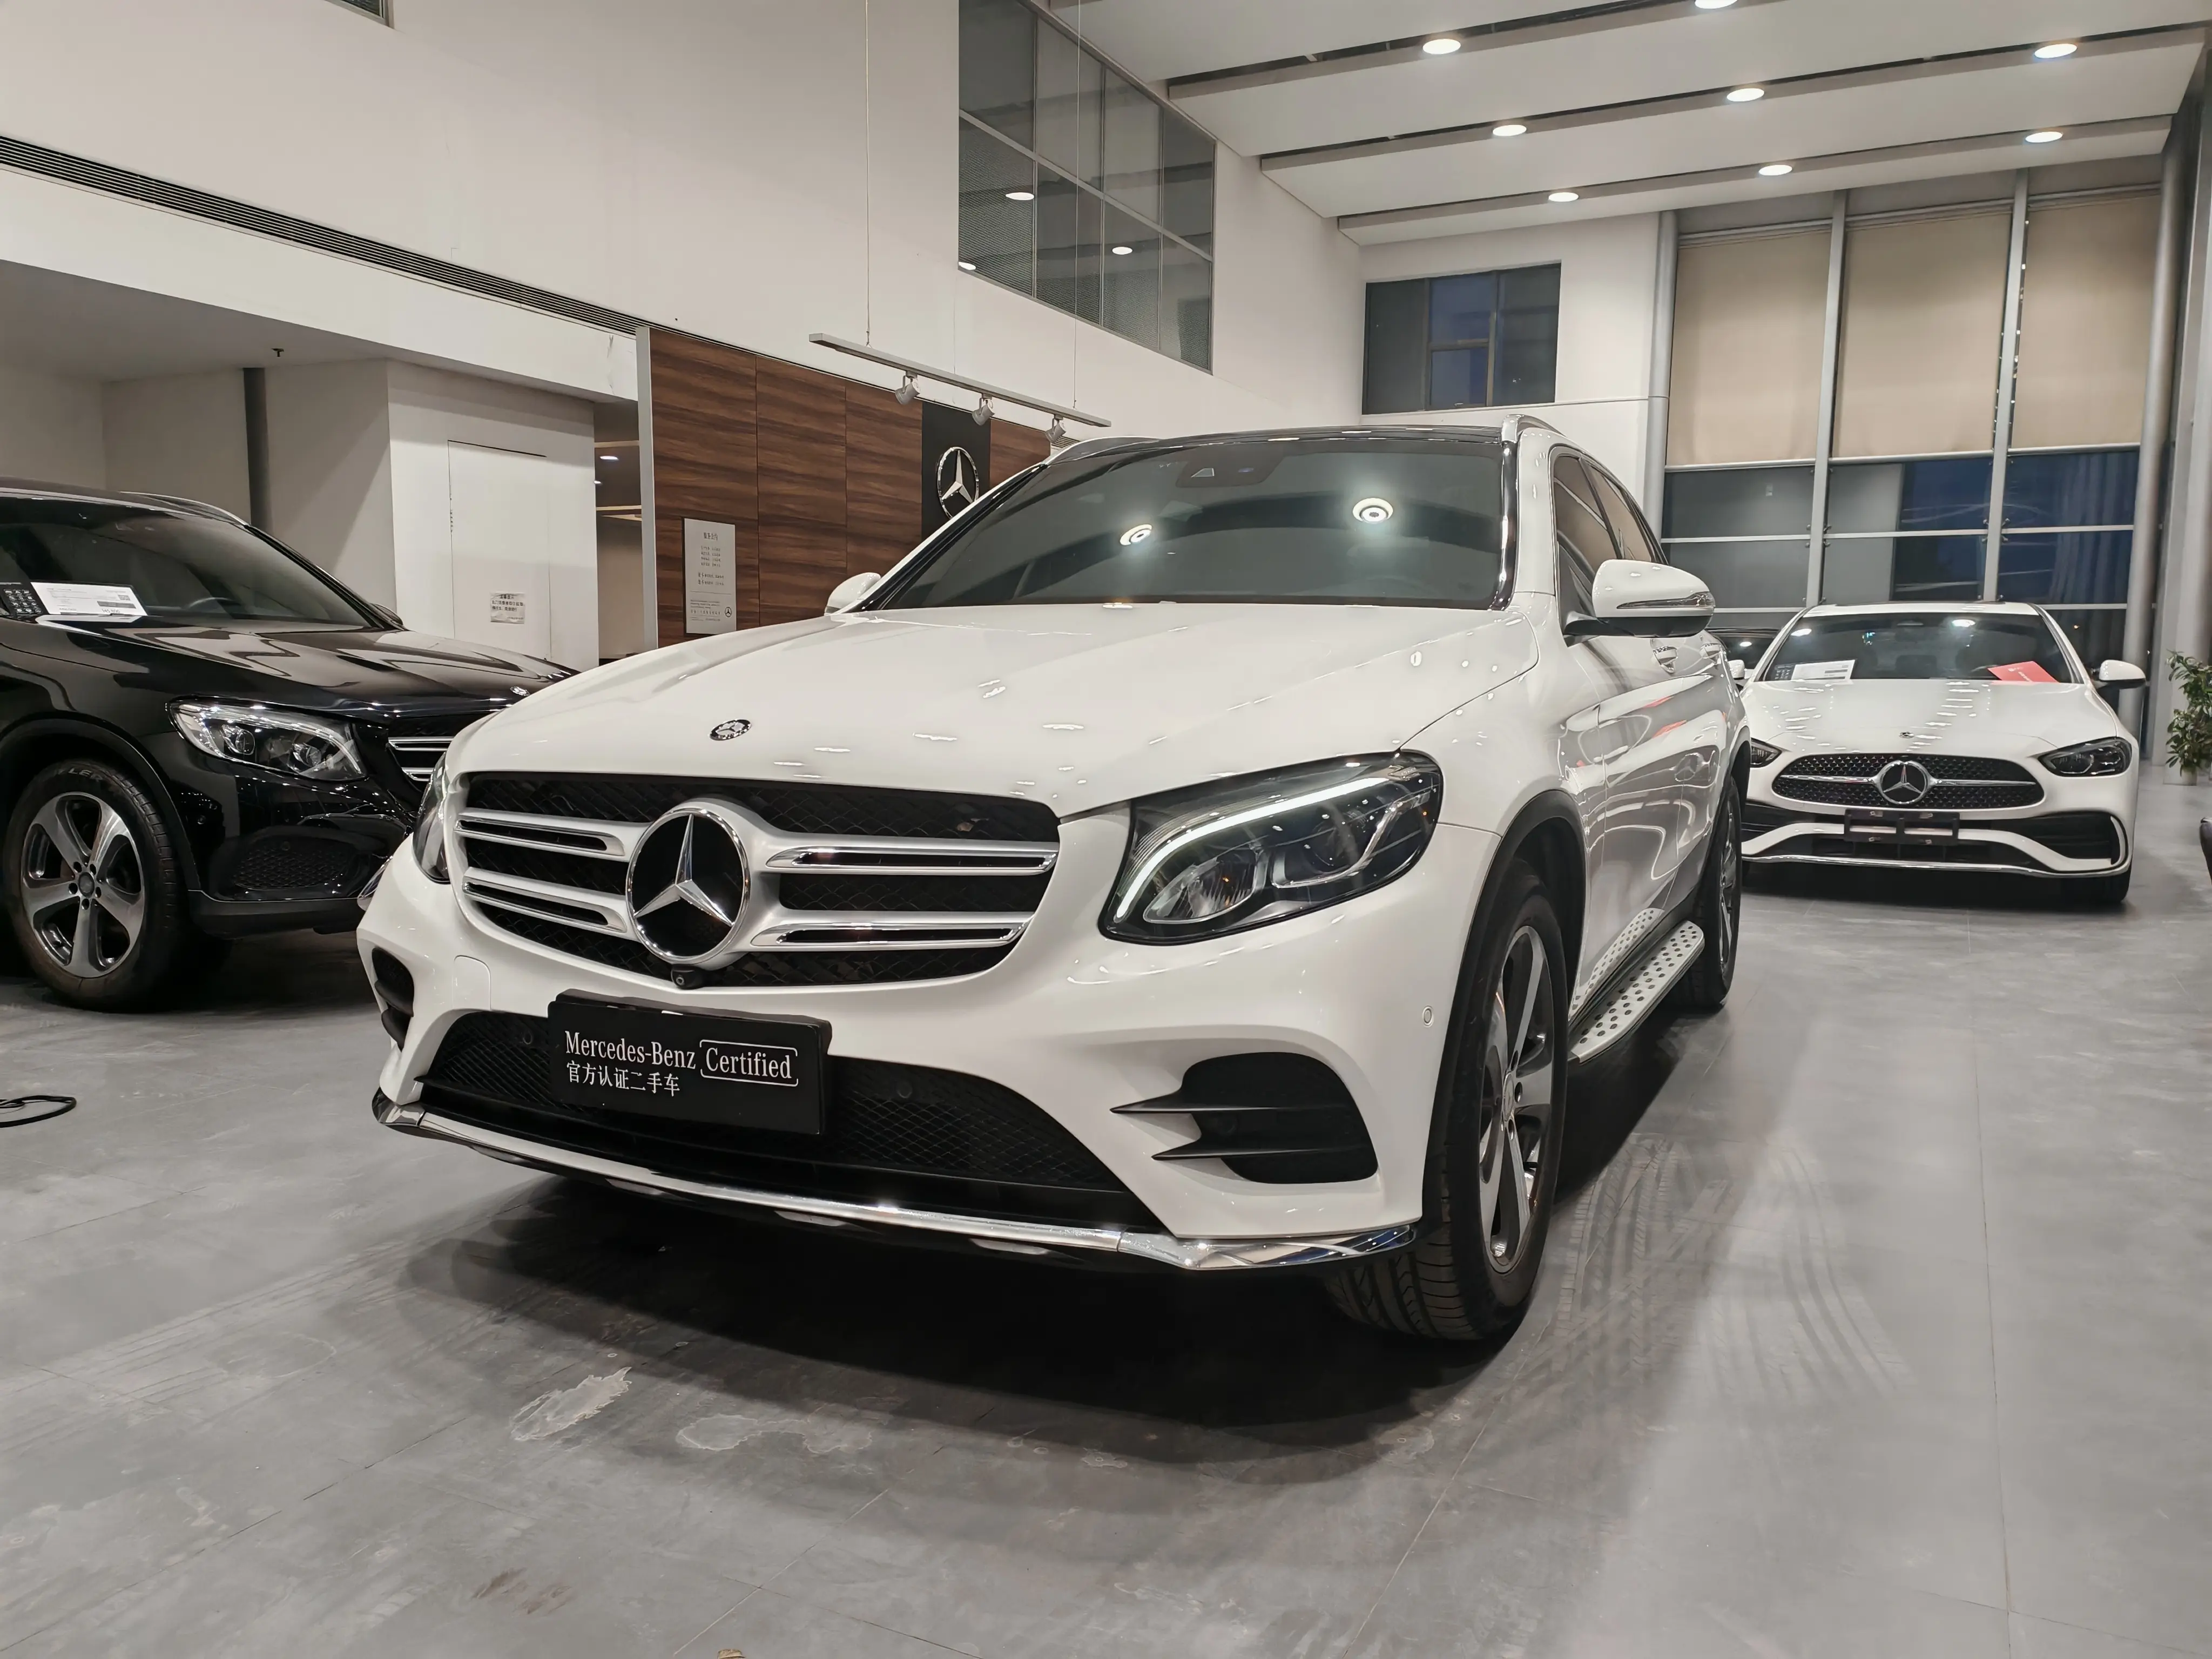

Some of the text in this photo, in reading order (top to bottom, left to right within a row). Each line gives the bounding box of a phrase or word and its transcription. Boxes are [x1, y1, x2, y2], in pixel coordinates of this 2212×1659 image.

[565, 1030, 792, 1079] Mercedes-Benz Certified
[566, 1061, 680, 1097] 官方认证二手车
